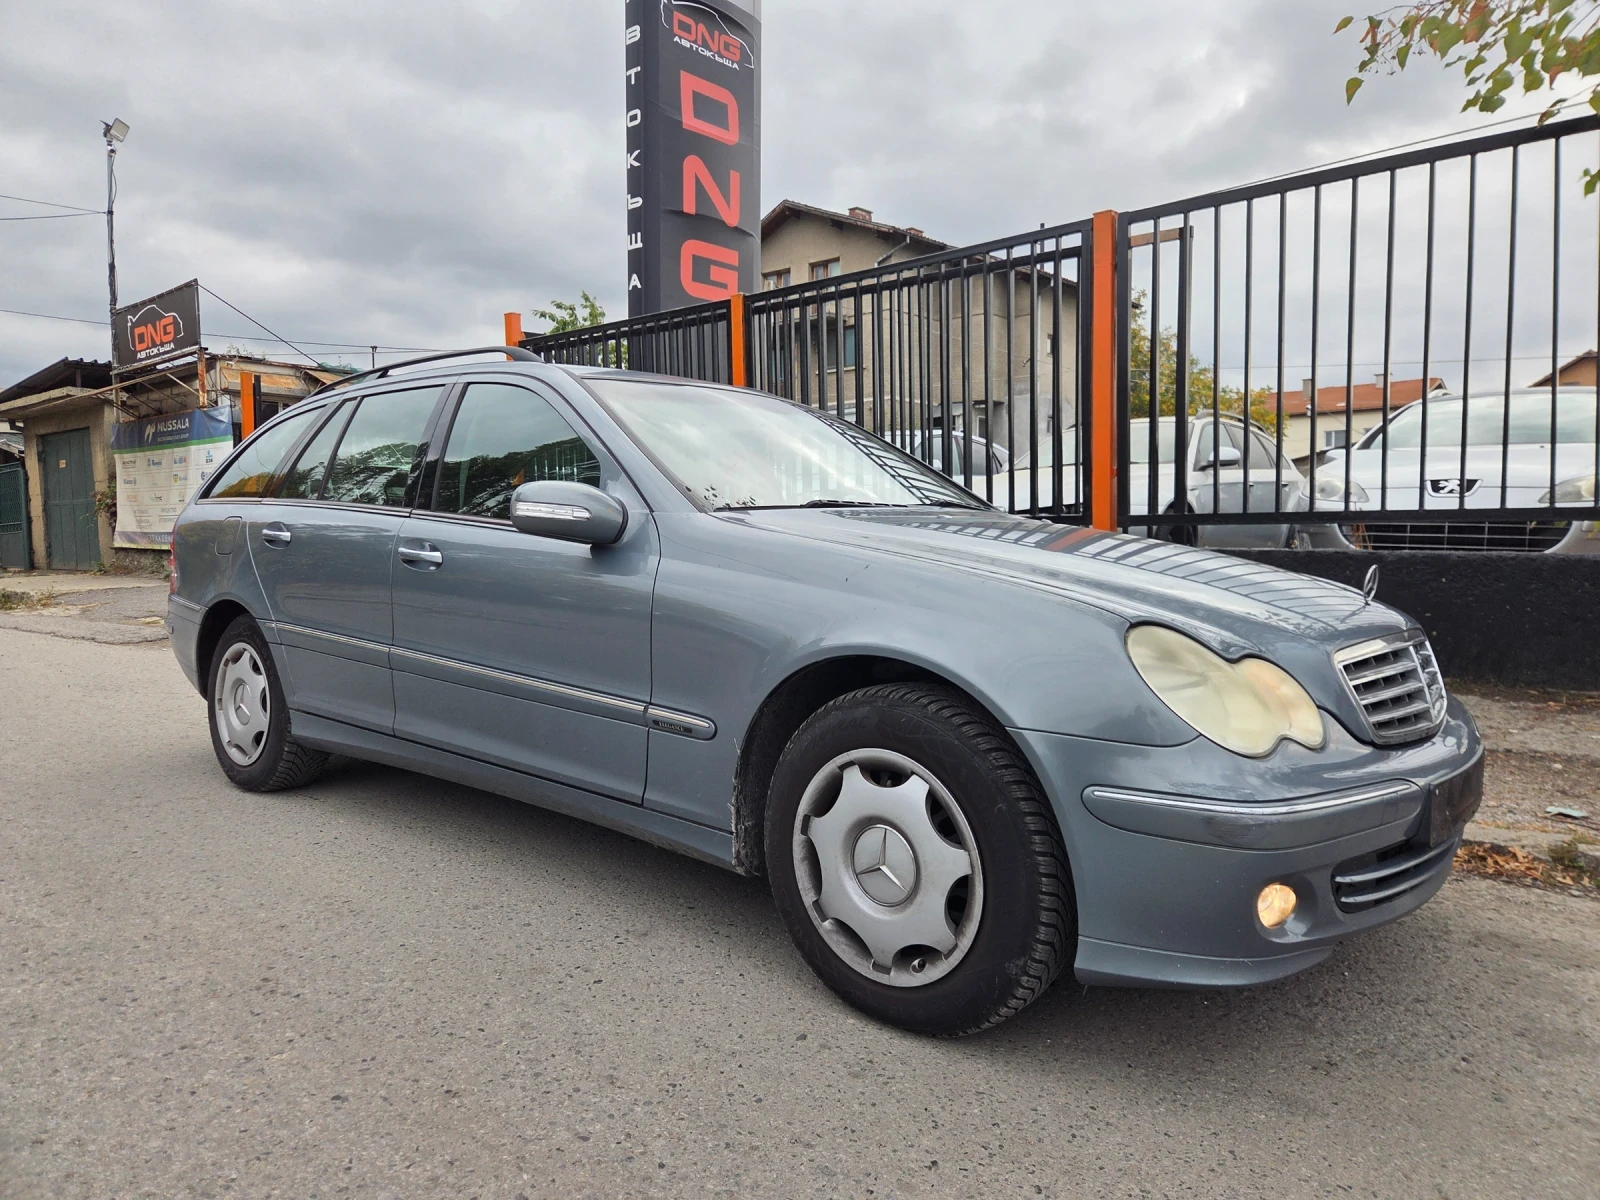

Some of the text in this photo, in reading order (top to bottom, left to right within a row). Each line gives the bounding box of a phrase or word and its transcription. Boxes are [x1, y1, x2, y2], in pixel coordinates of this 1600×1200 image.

[673, 11, 741, 62] DNG
[673, 36, 740, 70] АВТОКЪЩА
[626, 0, 643, 291] ВТОКЪЩА
[680, 70, 741, 302] DNG
[134, 315, 175, 351] DNG
[157, 417, 190, 432] MUSSALA
